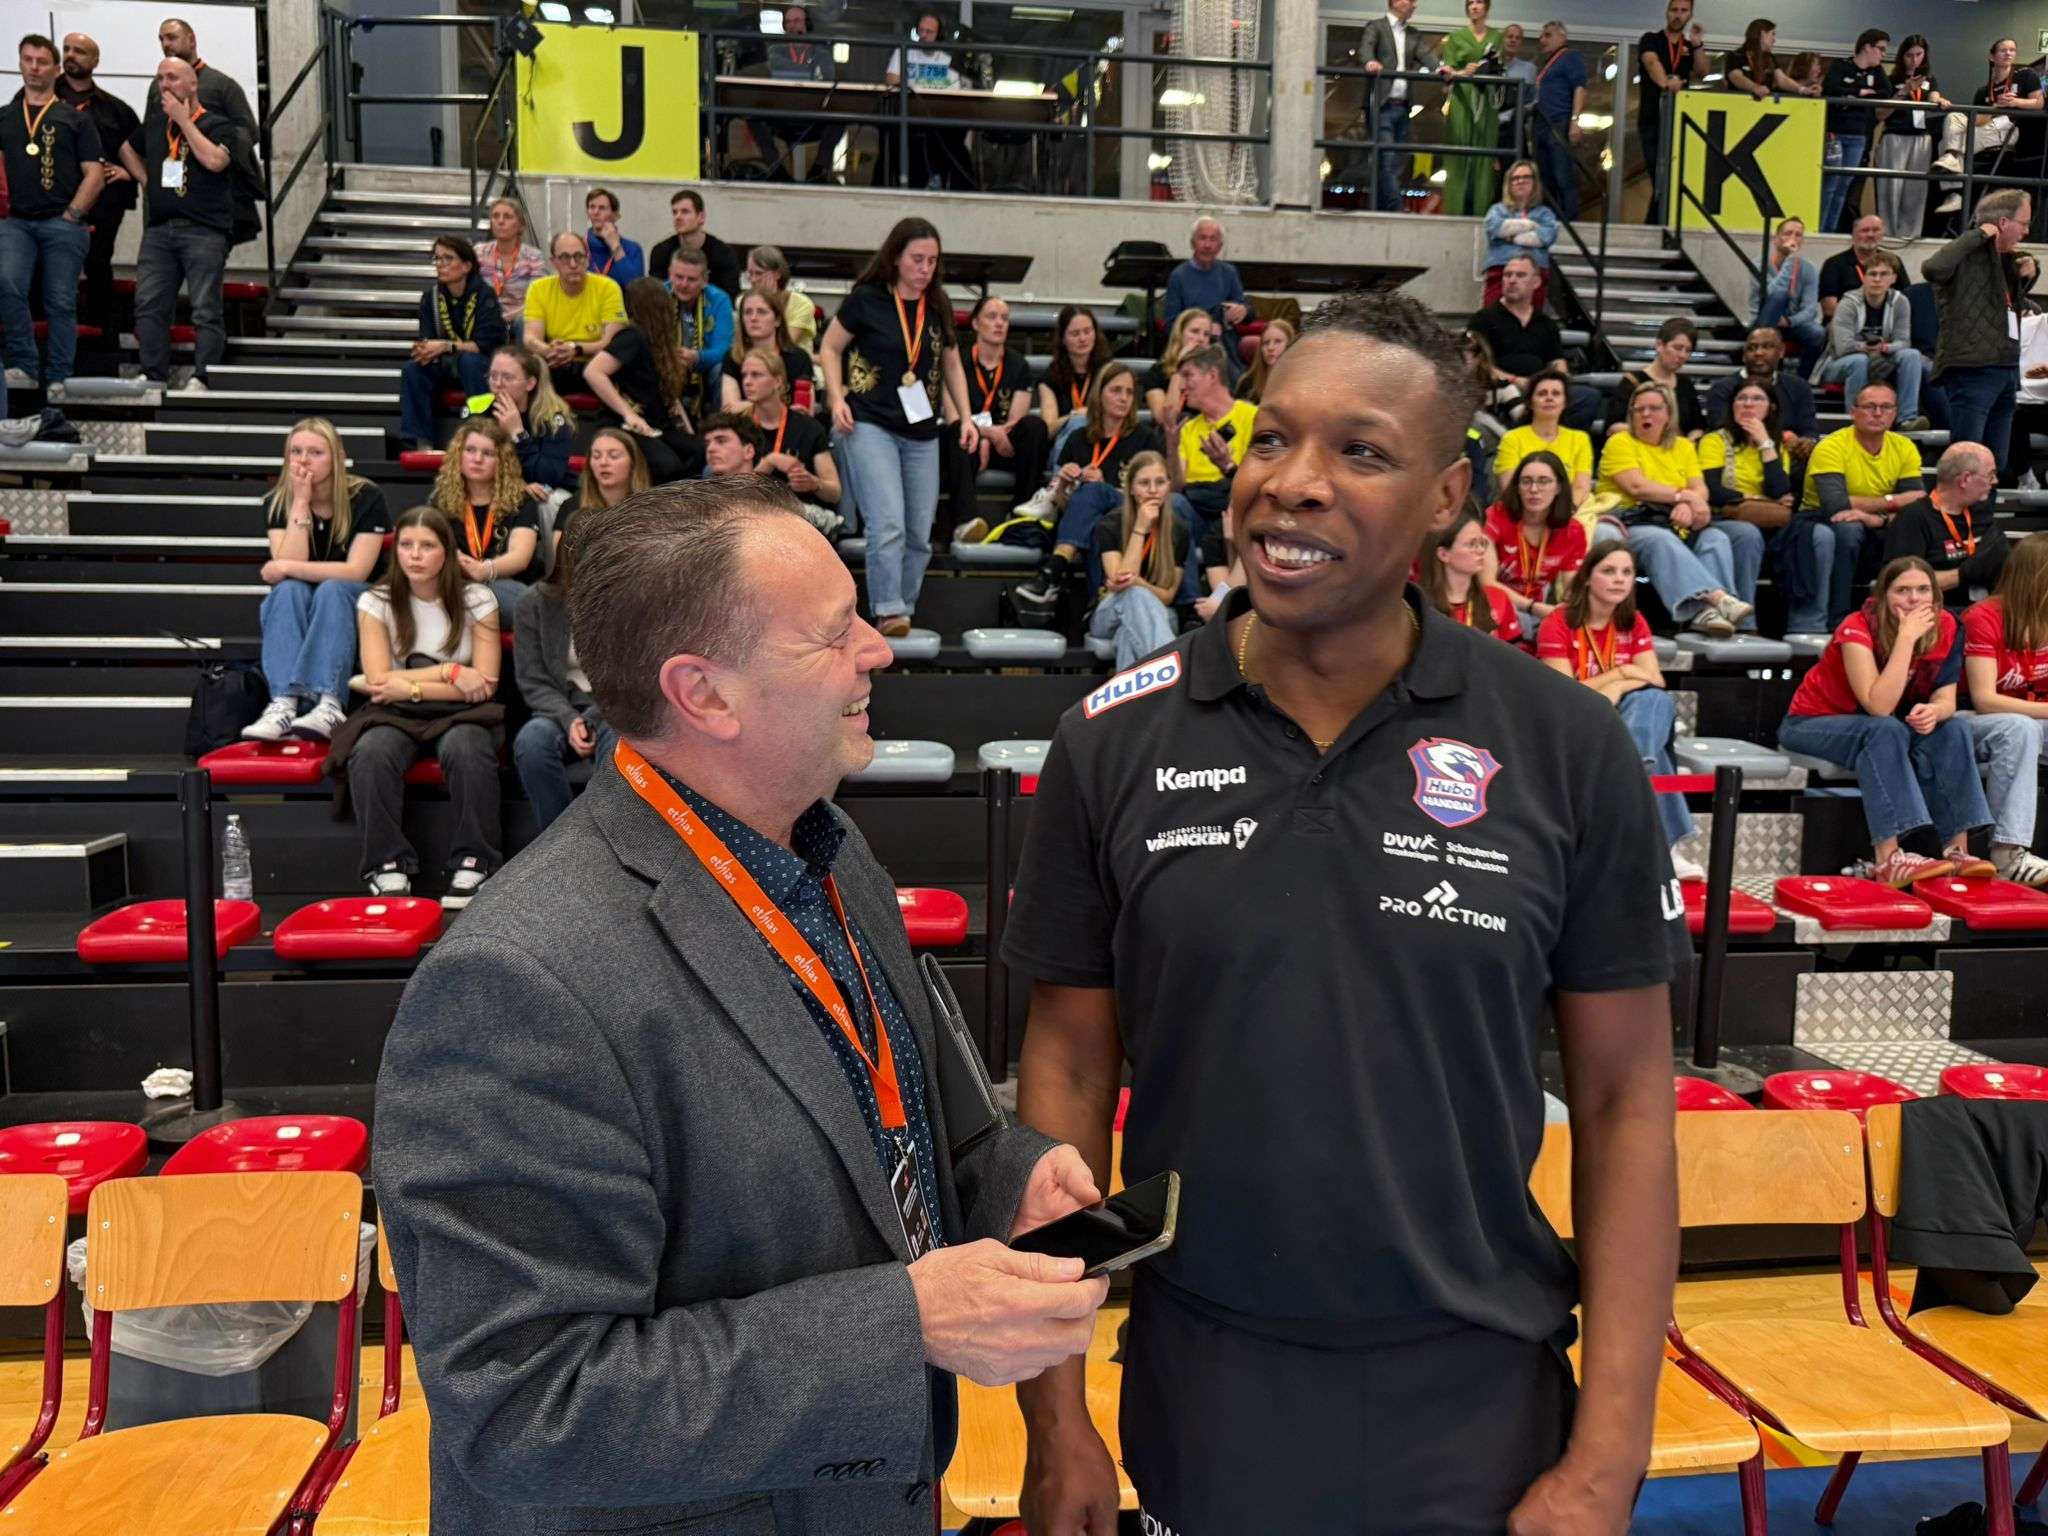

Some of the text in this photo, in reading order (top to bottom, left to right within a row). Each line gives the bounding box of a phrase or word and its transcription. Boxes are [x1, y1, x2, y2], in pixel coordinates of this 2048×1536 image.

[572, 45, 645, 161] J
[1703, 110, 1789, 218] K
[1091, 665, 1176, 710] Hubo
[1155, 765, 1247, 792] Kempa
[1428, 780, 1474, 797] Hubo
[667, 807, 696, 836] ethias
[1145, 831, 1231, 852] VRANCKEN
[709, 855, 737, 885] ethias
[751, 904, 779, 934] ethias
[1379, 895, 1508, 933] PRO ACTION
[793, 954, 819, 983] ethias
